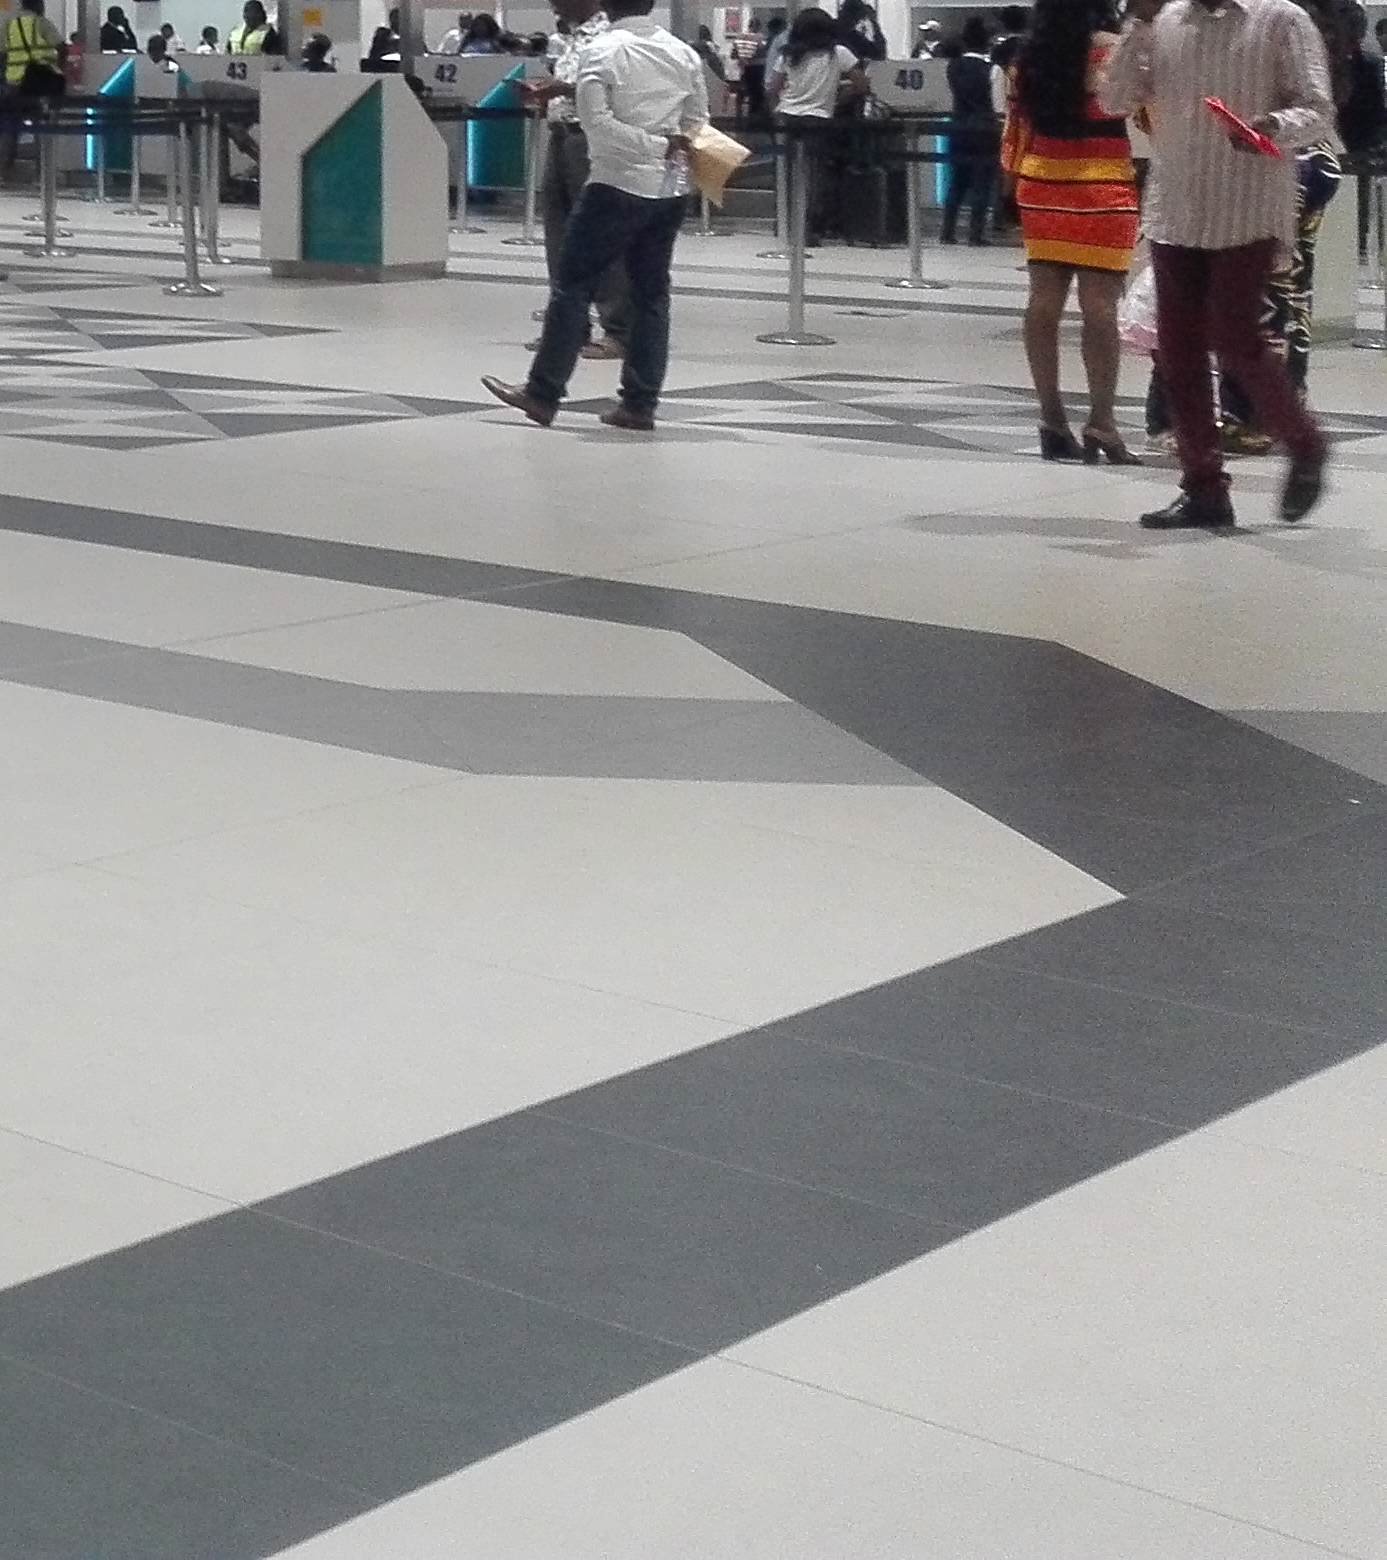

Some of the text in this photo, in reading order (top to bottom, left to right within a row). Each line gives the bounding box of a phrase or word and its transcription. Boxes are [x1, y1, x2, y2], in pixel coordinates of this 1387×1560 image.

[227, 62, 247, 80] 43
[436, 64, 457, 83] 42
[895, 69, 925, 90] 40
